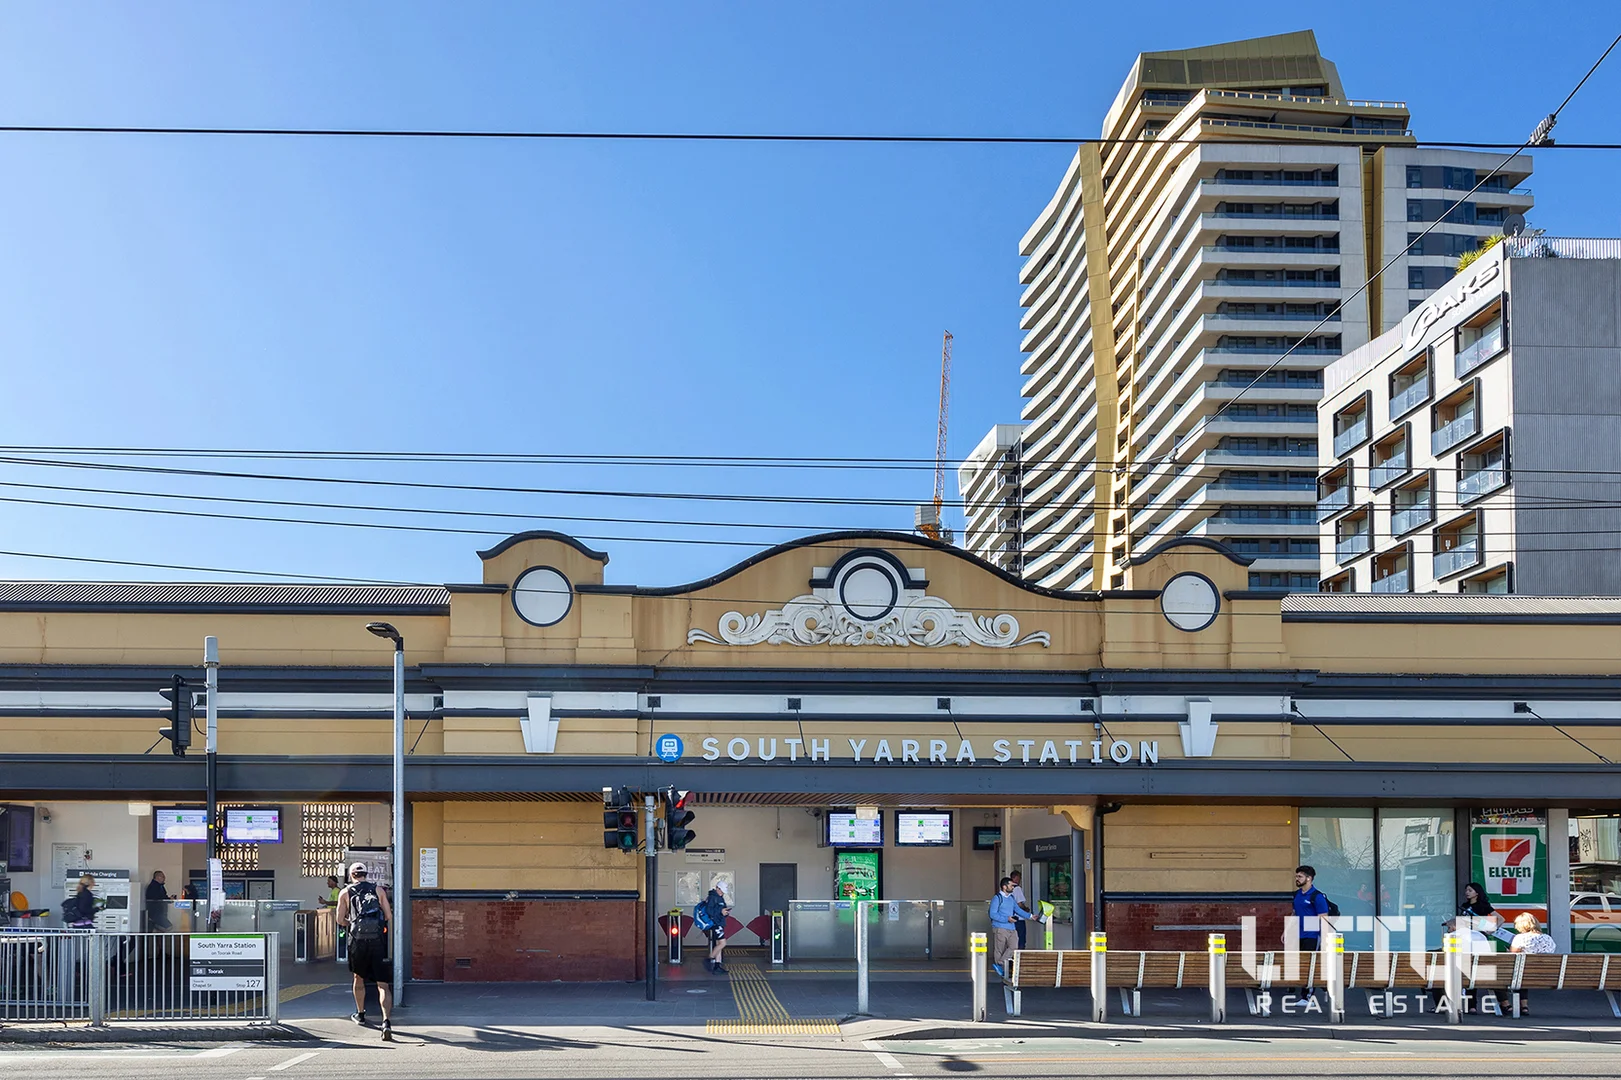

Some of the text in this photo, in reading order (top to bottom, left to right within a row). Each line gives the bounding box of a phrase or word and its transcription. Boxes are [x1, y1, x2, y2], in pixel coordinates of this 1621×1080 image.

[1404, 260, 1500, 352] OAKS
[701, 736, 1160, 766] SOUTH YARRA STATION
[246, 979, 261, 988] 127
